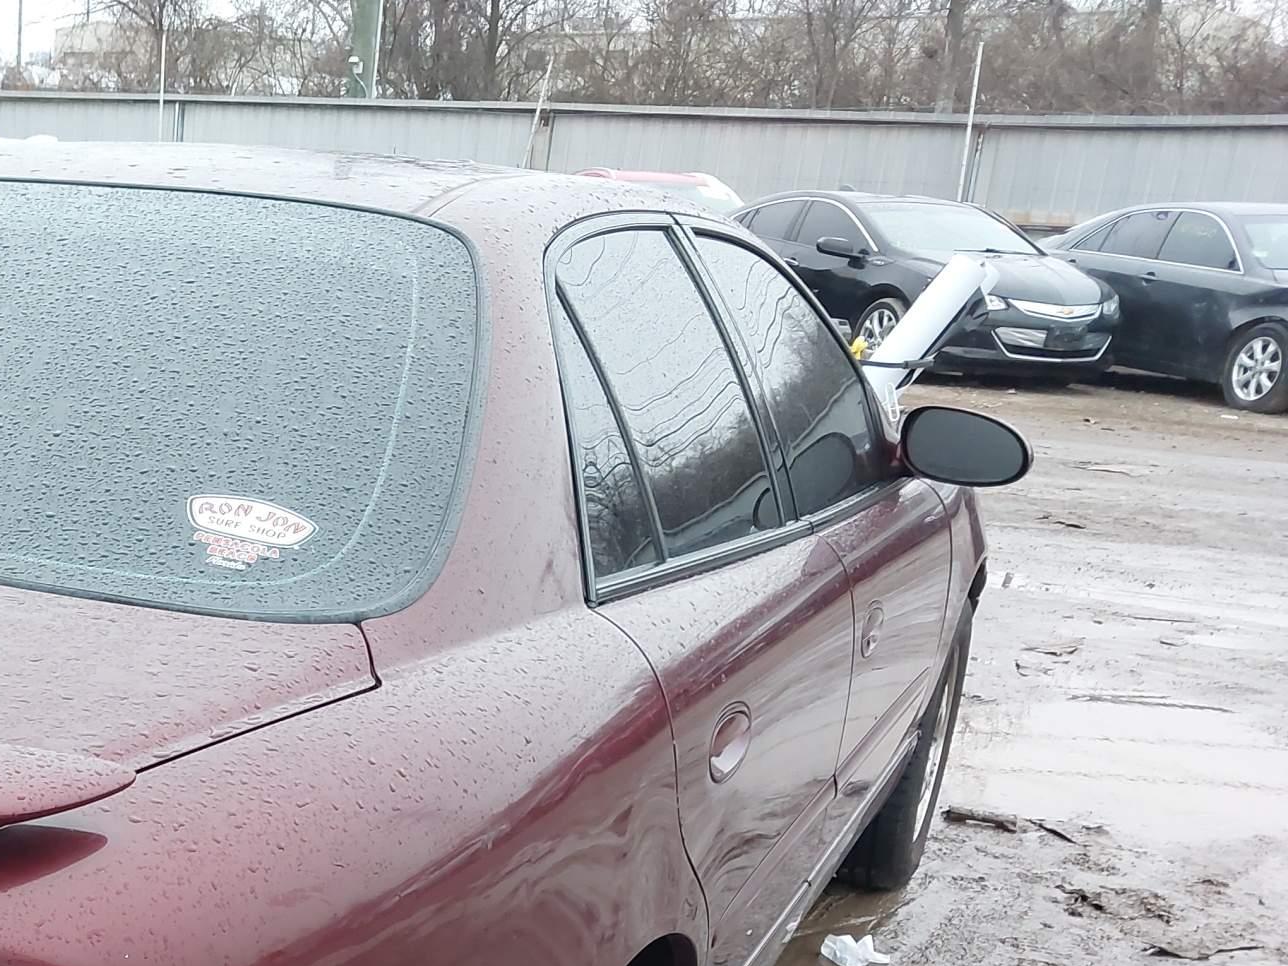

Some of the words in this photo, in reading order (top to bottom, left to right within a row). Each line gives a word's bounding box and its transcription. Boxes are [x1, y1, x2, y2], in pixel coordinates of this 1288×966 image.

[198, 501, 254, 518] RON
[256, 511, 308, 535] JON
[208, 515, 242, 529] SURF
[247, 524, 287, 540] SHOP
